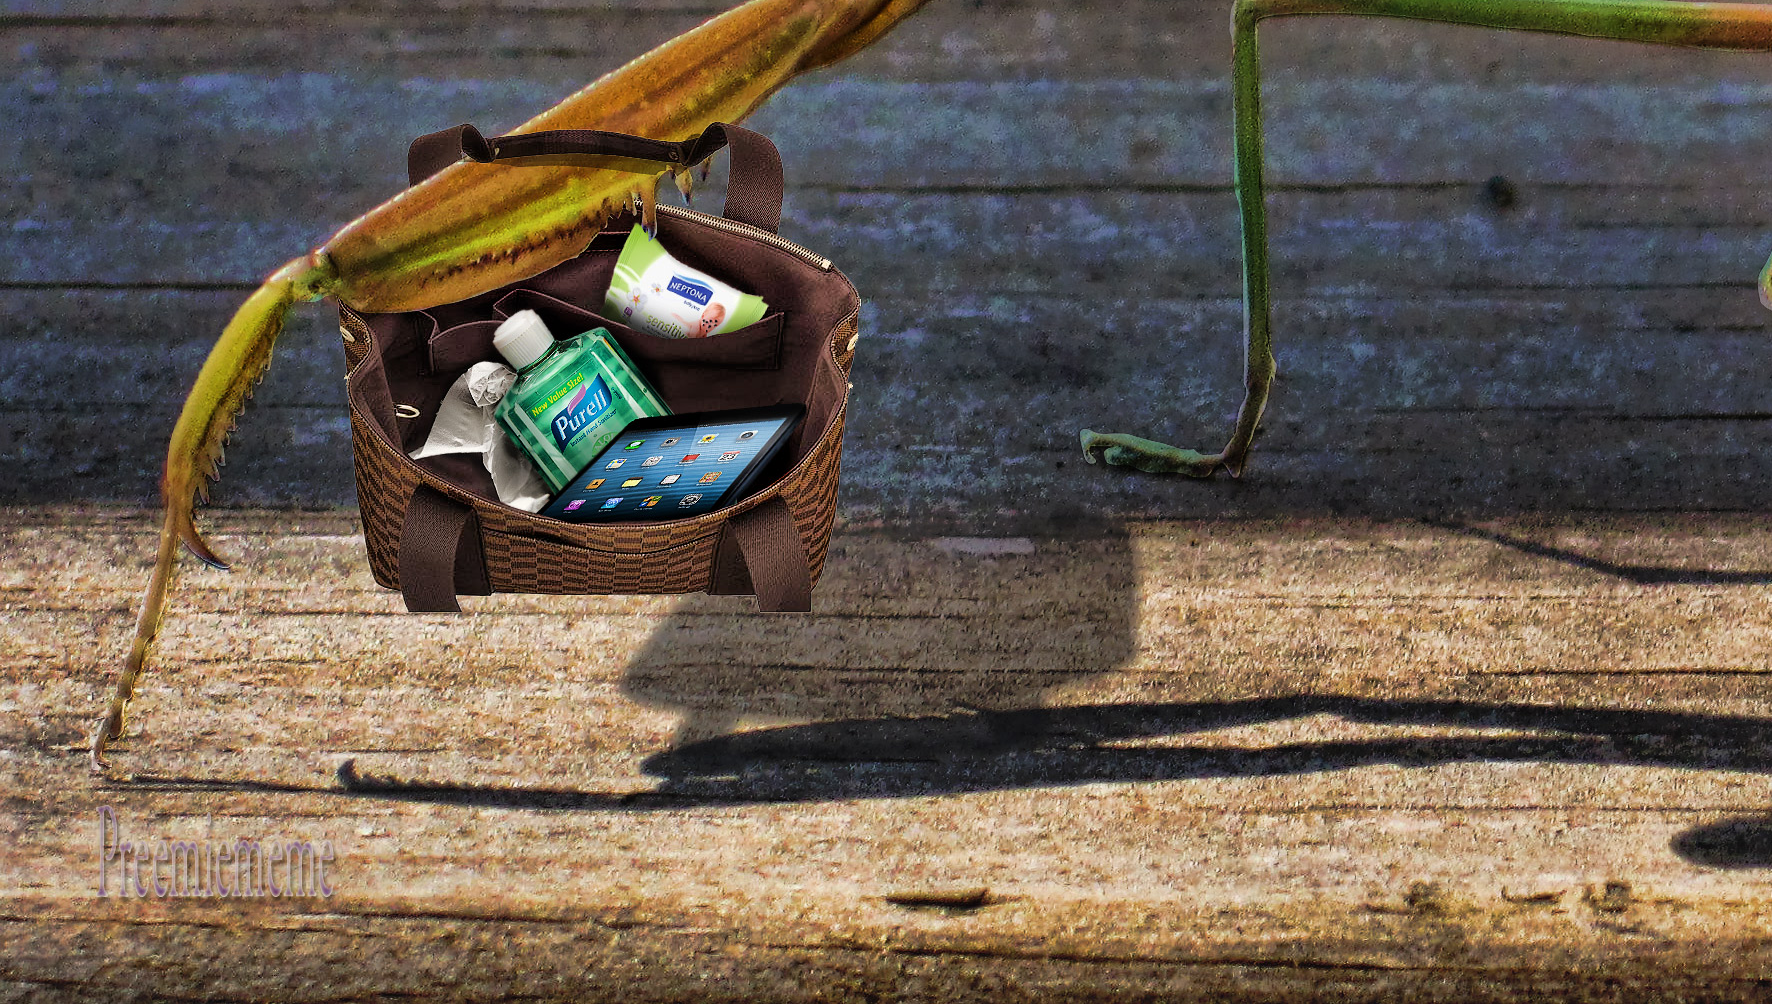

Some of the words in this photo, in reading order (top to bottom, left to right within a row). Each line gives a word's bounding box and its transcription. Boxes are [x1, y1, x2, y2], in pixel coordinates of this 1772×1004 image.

[669, 281, 707, 303] NEPTONA
[531, 400, 548, 417] New
[547, 386, 568, 405] Value
[567, 372, 585, 390] Size!
[555, 388, 607, 441] Purell
[586, 422, 598, 436] Hand
